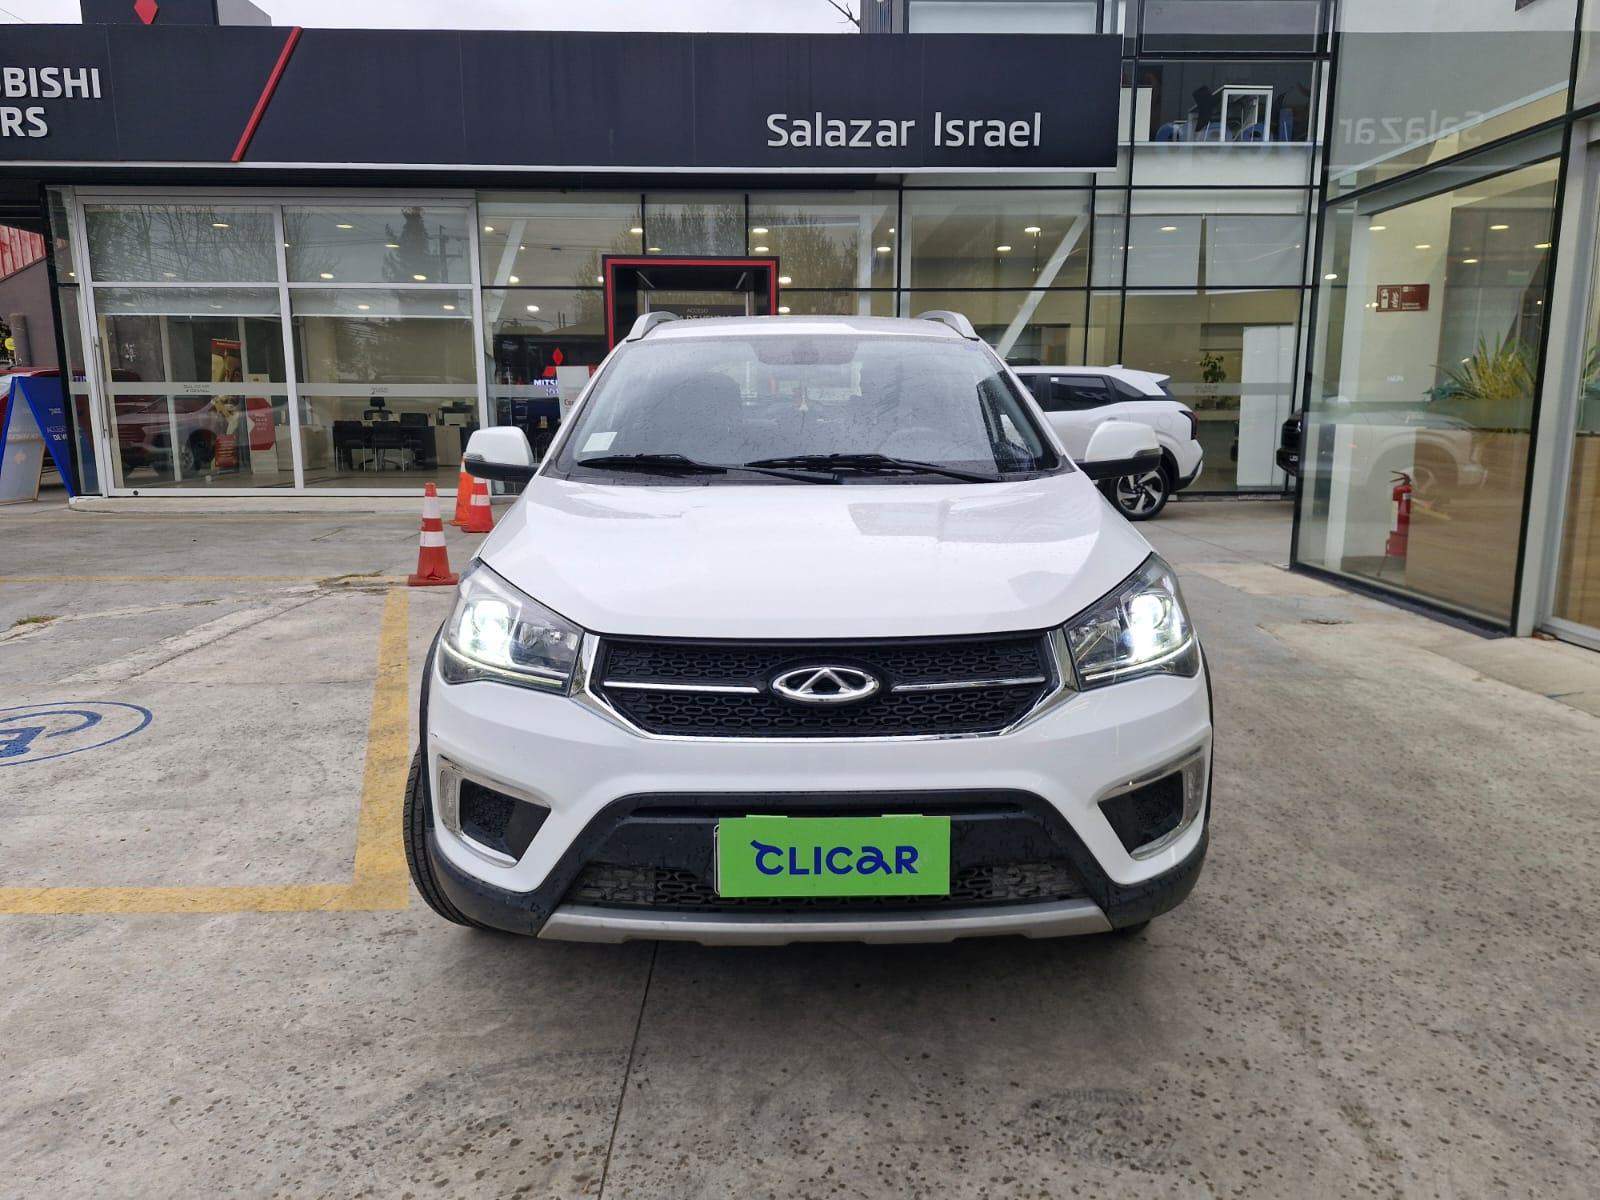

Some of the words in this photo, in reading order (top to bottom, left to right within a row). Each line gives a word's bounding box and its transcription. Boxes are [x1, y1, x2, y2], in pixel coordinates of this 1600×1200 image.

[0, 67, 102, 99] BISHI
[766, 111, 916, 148] Salazar
[934, 111, 1042, 148] Israel
[750, 839, 919, 876] CLICAR
